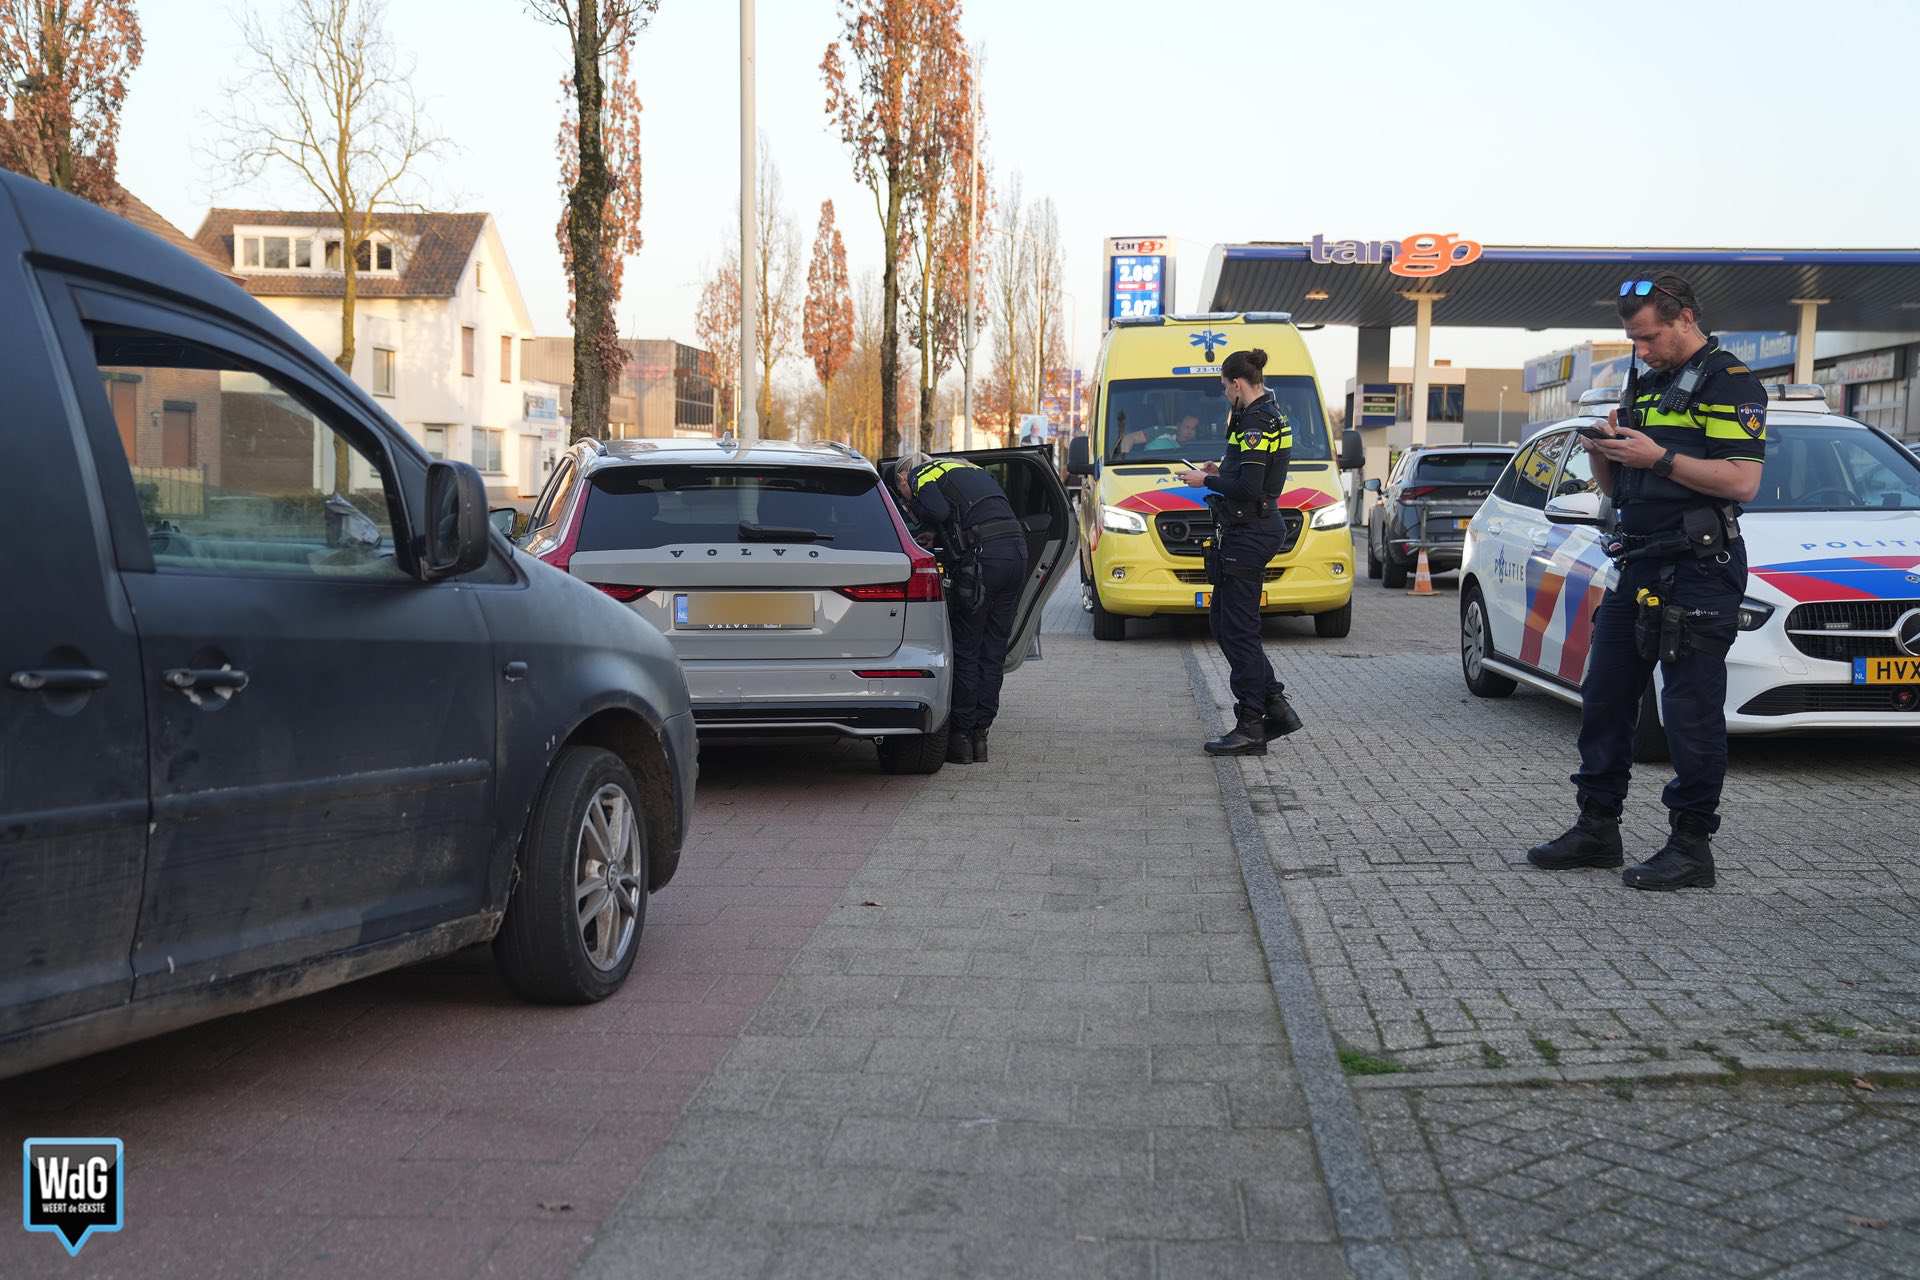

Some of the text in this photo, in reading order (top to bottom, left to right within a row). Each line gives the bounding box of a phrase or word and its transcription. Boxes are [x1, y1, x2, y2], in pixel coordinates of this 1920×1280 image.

[1306, 233, 1483, 277] tango
[670, 548, 819, 558] VOLVO
[1494, 557, 1525, 584] POLITIE
[1854, 672, 1865, 681] NL
